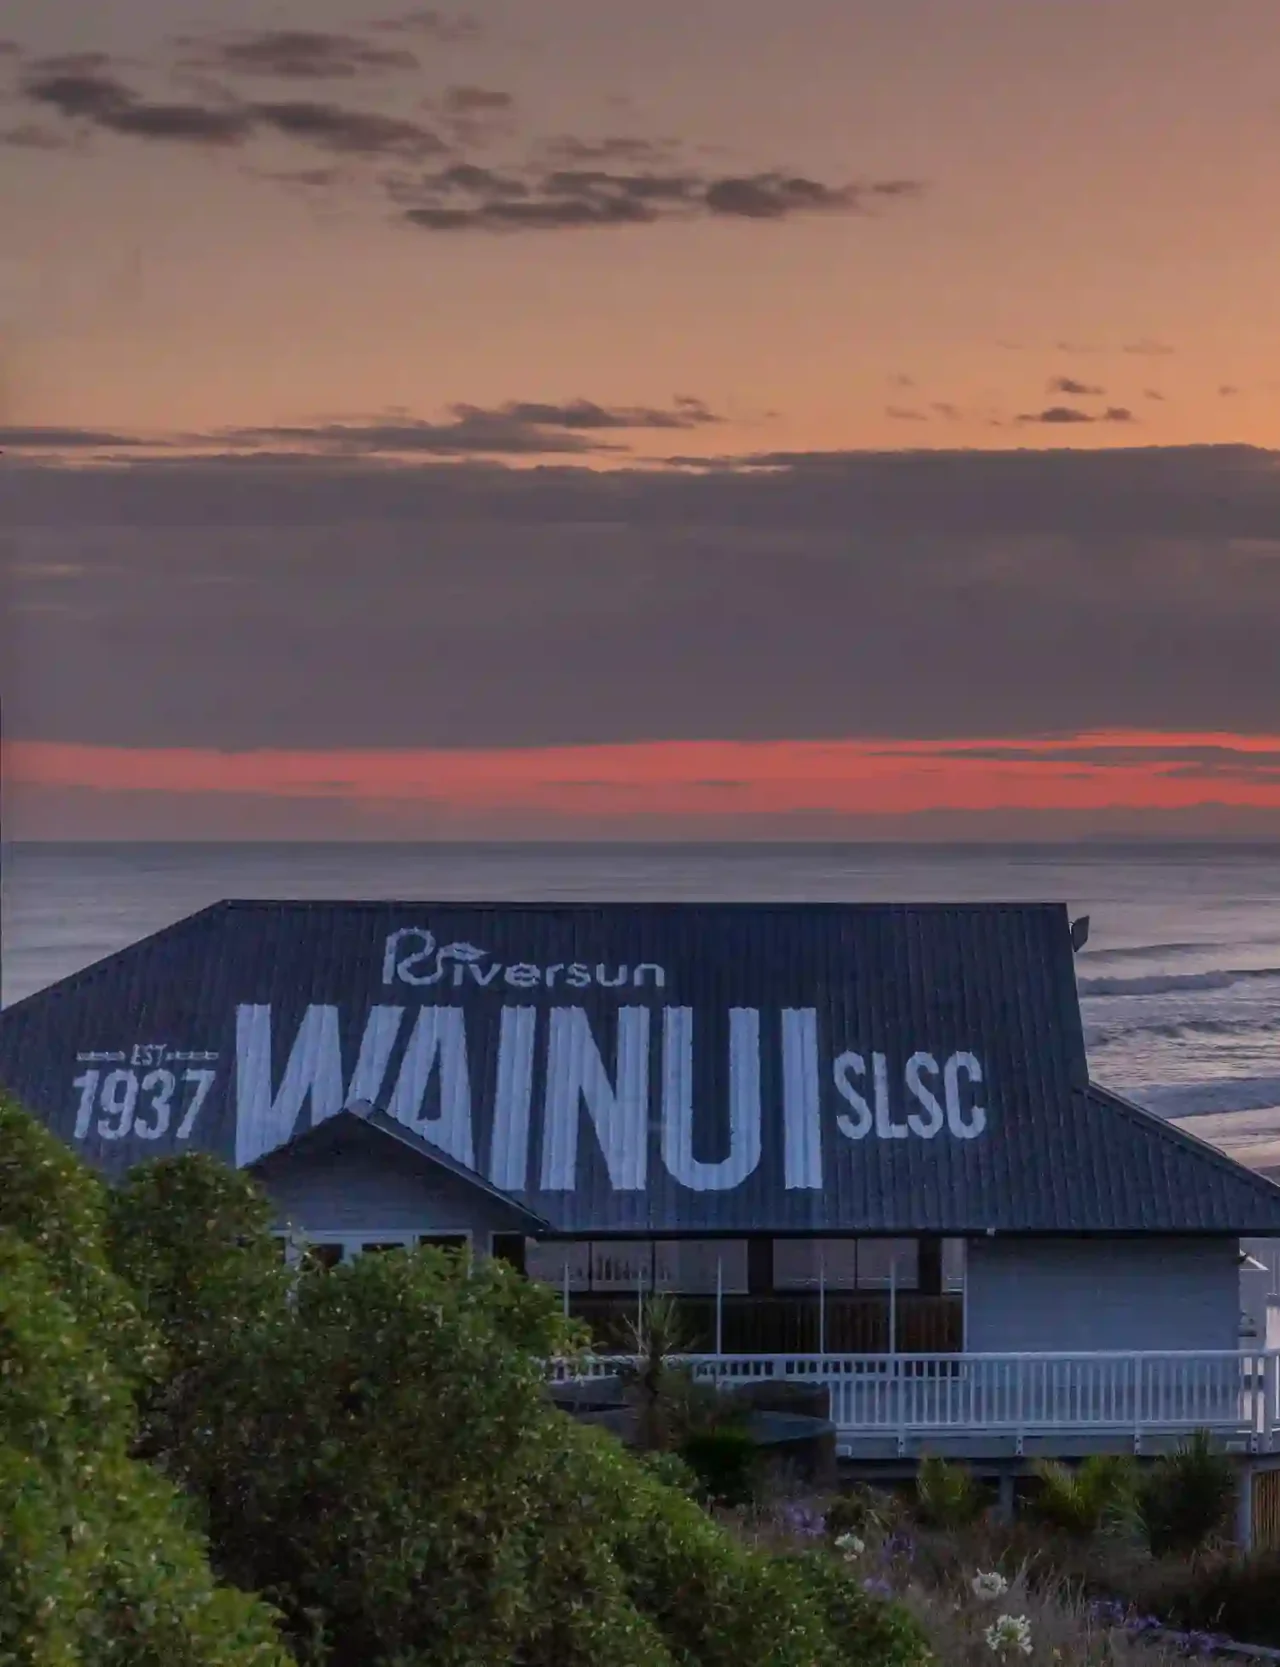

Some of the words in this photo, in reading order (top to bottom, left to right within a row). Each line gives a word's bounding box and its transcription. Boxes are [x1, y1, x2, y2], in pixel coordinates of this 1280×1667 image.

[382, 926, 666, 987] Riversun
[130, 1043, 167, 1066] EST
[72, 1068, 216, 1140] 1937
[235, 1003, 823, 1190] WAINUI
[833, 1050, 987, 1139] SLSC
